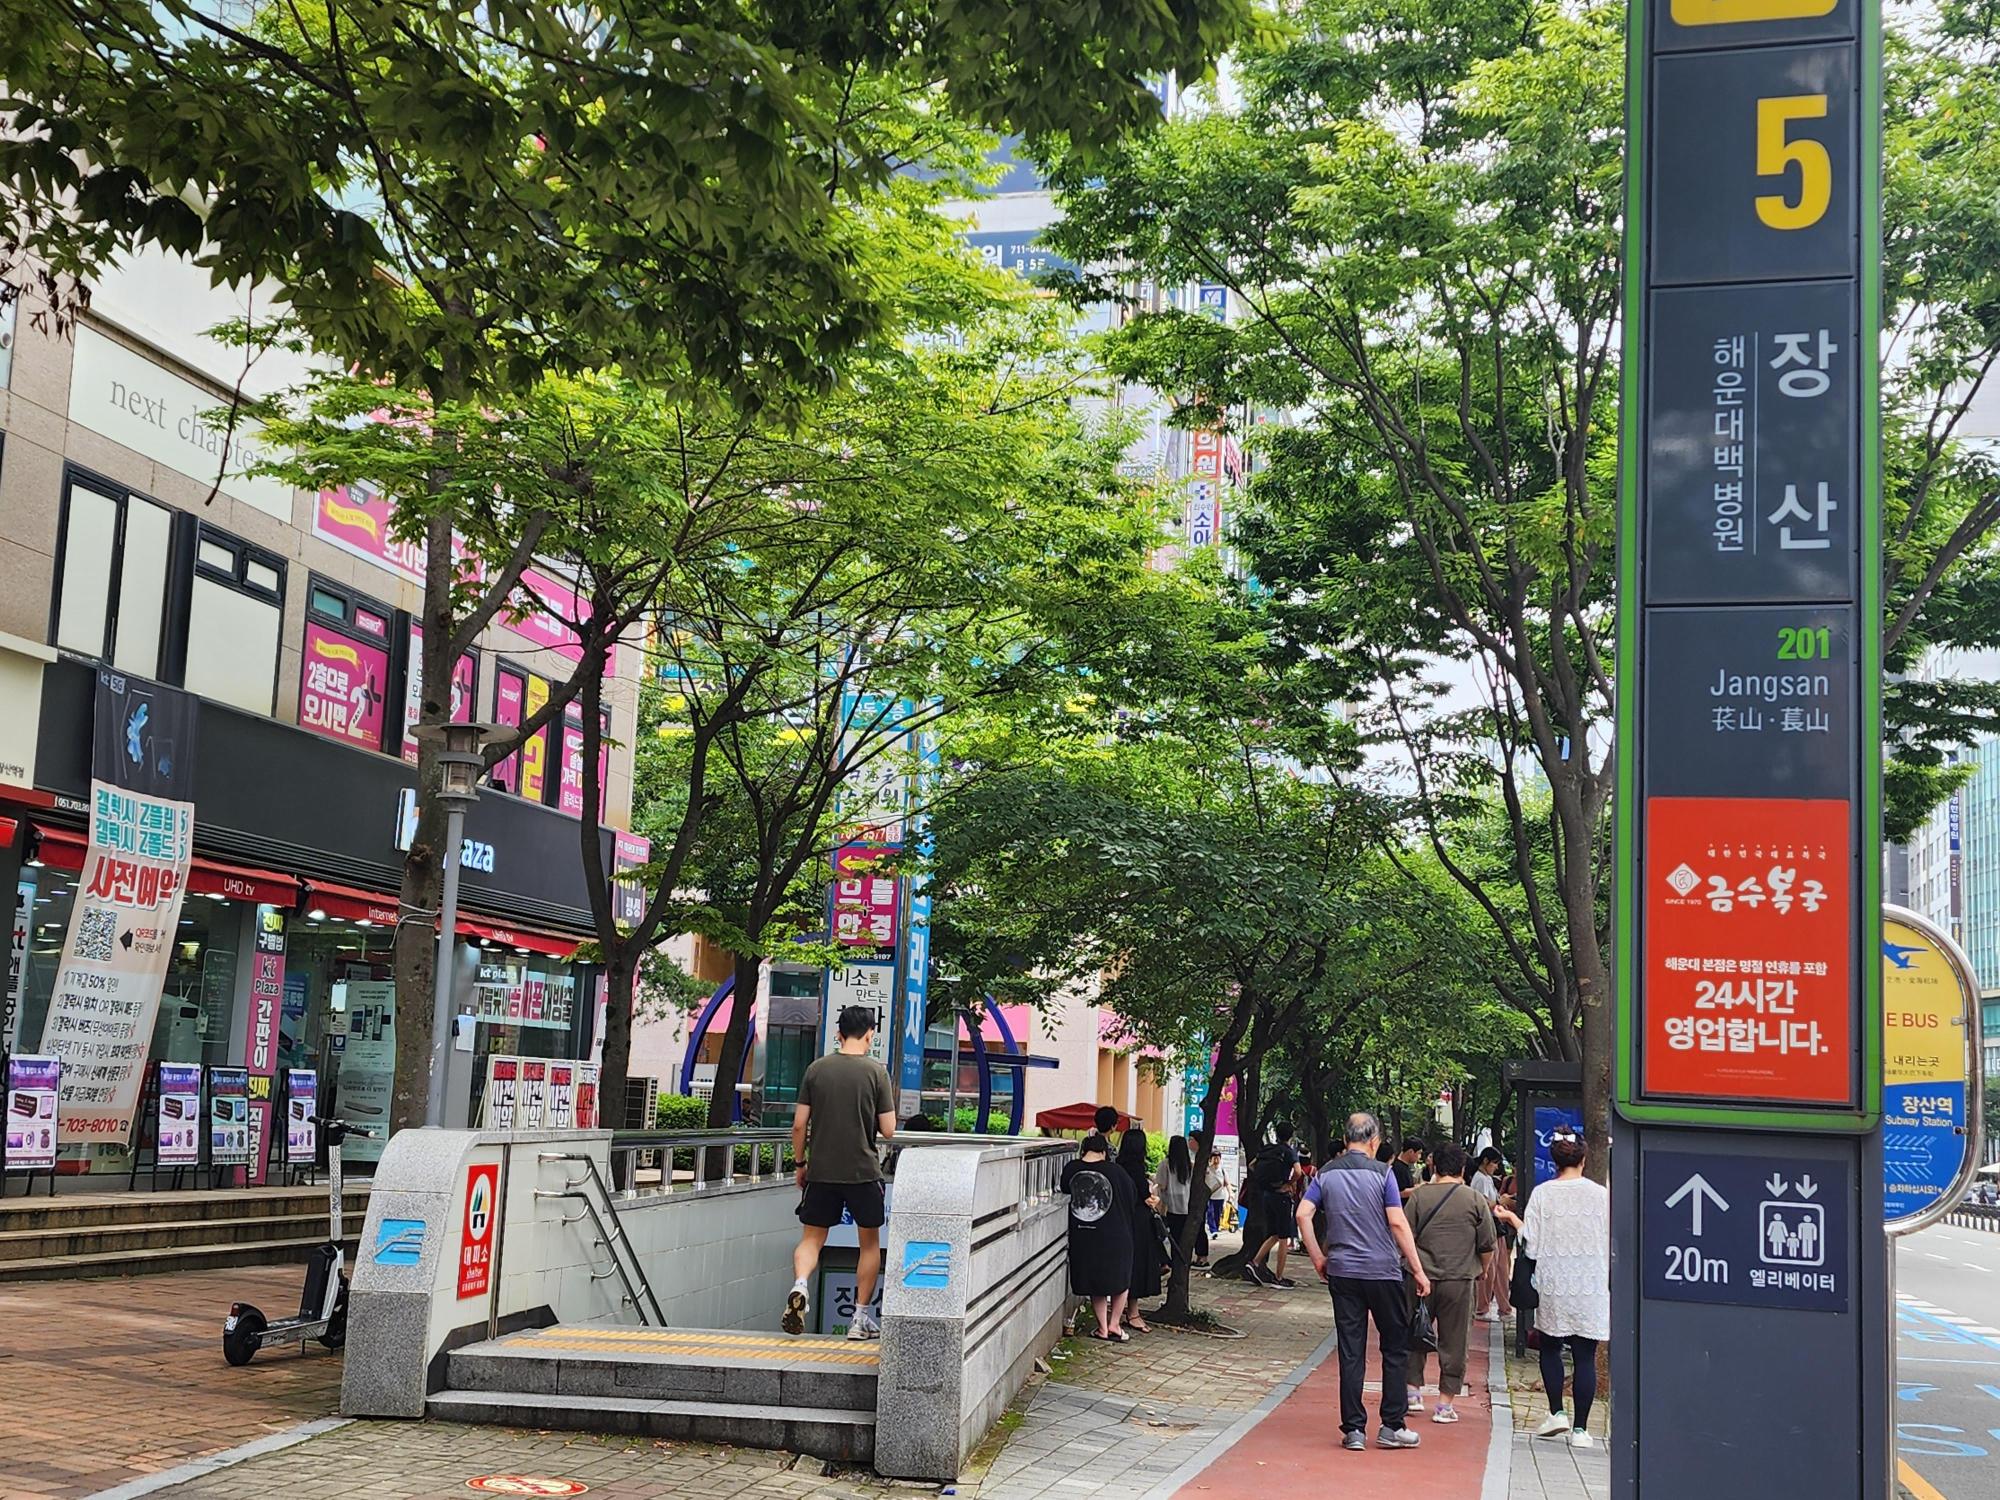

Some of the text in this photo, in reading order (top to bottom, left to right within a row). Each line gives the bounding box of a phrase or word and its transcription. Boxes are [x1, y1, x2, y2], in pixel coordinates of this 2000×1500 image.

[1754, 94, 1832, 230] 5
[109, 381, 168, 430] next
[1712, 335, 1746, 552] 해운대백병원
[1768, 329, 1838, 549] 장산
[1777, 626, 1830, 660] 201
[306, 661, 349, 701] 2층으로
[1710, 668, 1829, 702] Jangsan
[303, 694, 348, 734] 오시면
[96, 789, 137, 825] 갤럭시
[139, 803, 176, 835] Z플립
[95, 818, 136, 856] 갤럭시
[138, 831, 175, 860] Z폴드
[224, 879, 256, 896] UHD tv
[1705, 865, 1828, 916] 금수복국
[262, 912, 284, 932] 진짜
[258, 932, 284, 951] 구별법
[261, 955, 277, 979] kt
[480, 967, 491, 978] kt
[1664, 957, 1828, 976] 해운대 본점은 명절 연휴를 포함
[254, 980, 280, 996] Plaza
[856, 989, 889, 1003] 만드는
[1694, 978, 1799, 1014] 24시간
[252, 999, 273, 1071] 간판이
[1664, 1016, 1829, 1056] 영업합니다.
[1902, 1013, 1939, 1028] BUS
[1884, 1114, 1953, 1127] Subway Station
[1902, 1096, 1953, 1115] 장산역
[463, 1245, 489, 1266] 대피소
[1664, 1245, 1729, 1284] 20m
[1749, 1269, 1835, 1293] 엘리베이터
